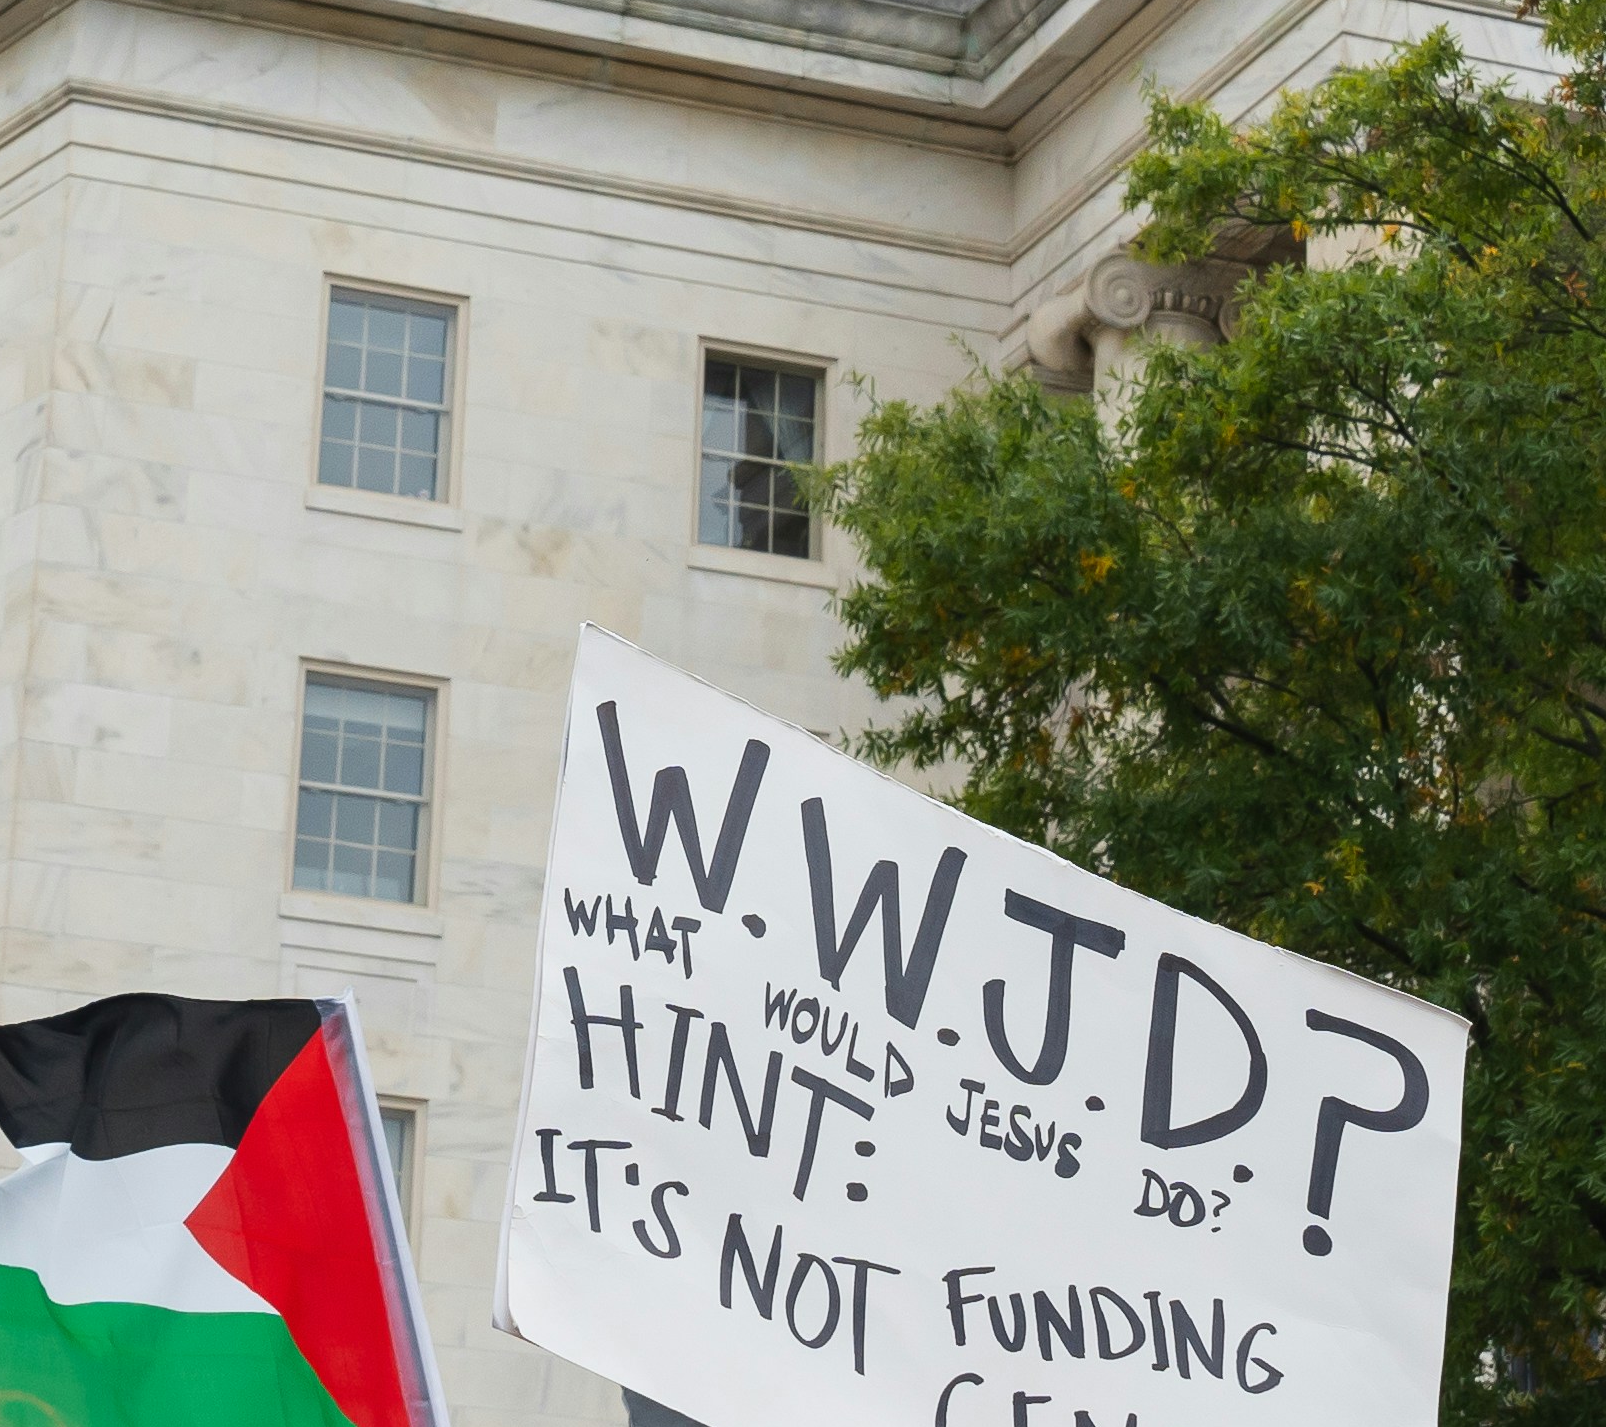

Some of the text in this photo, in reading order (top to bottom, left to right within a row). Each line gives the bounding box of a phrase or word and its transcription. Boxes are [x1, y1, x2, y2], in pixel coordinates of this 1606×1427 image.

[562, 965, 875, 1203] HINT:
[563, 886, 1231, 1235] WHAT WOULD JESUS DO?
[533, 1128, 1285, 1395] IT'S NOT FUNDING
